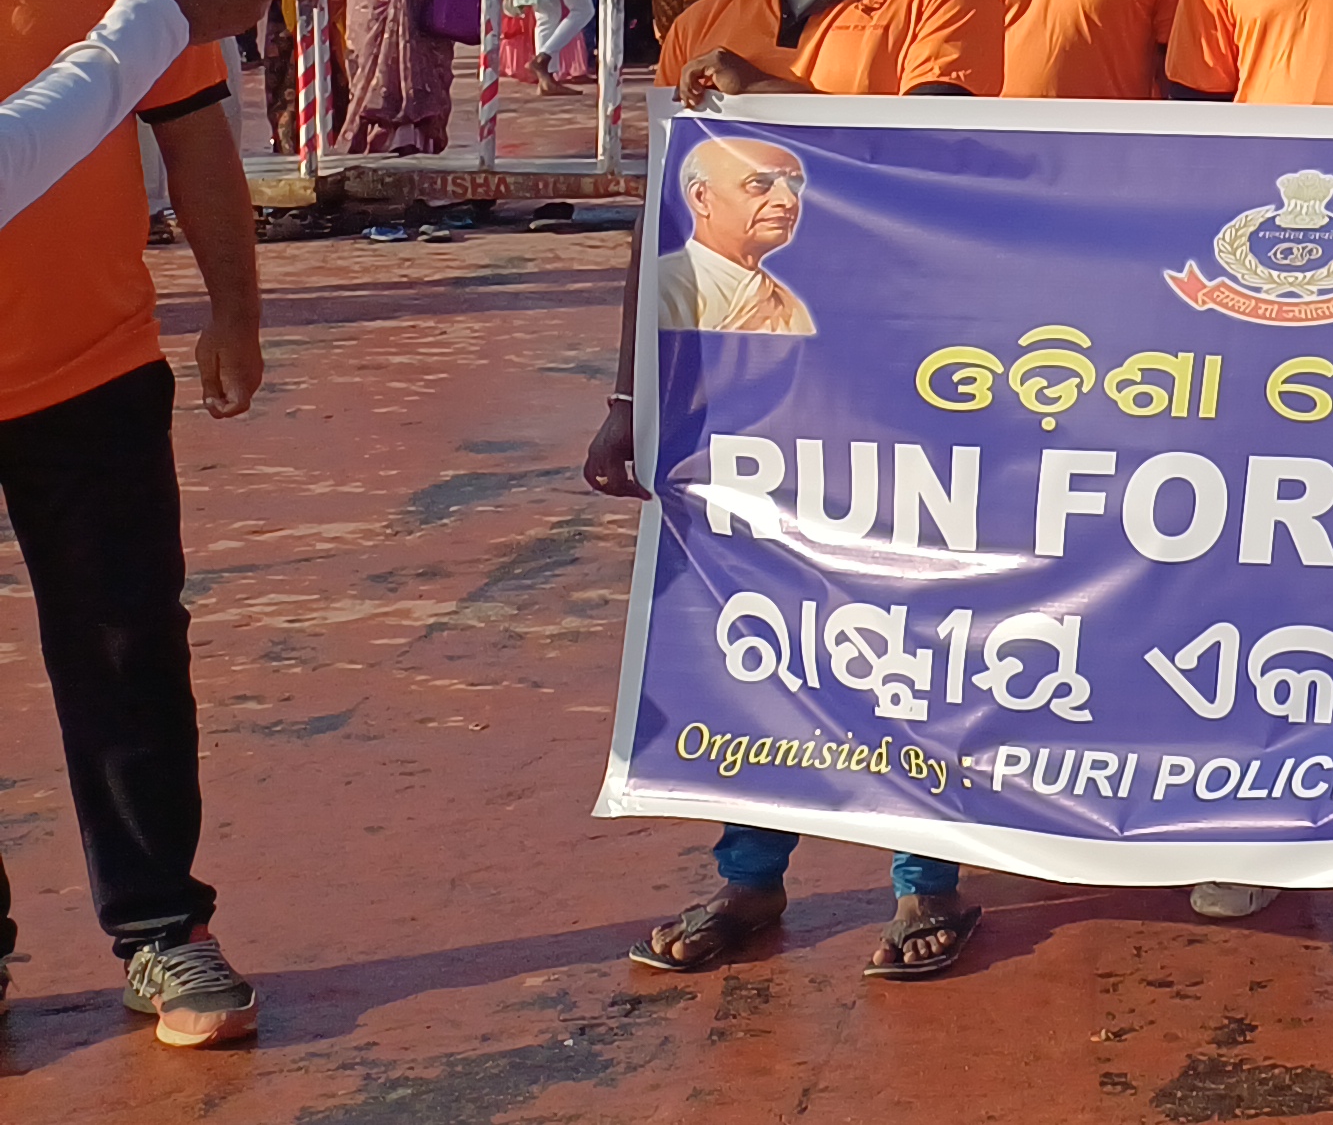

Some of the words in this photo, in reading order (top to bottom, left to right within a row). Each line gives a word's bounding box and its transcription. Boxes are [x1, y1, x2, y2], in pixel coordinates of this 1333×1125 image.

[916, 324, 1222, 431] ଓଡ଼ିଶା
[708, 434, 981, 553] RUN
[676, 722, 893, 776] Organisied
[901, 745, 947, 795] By
[992, 746, 1139, 797] PURI
